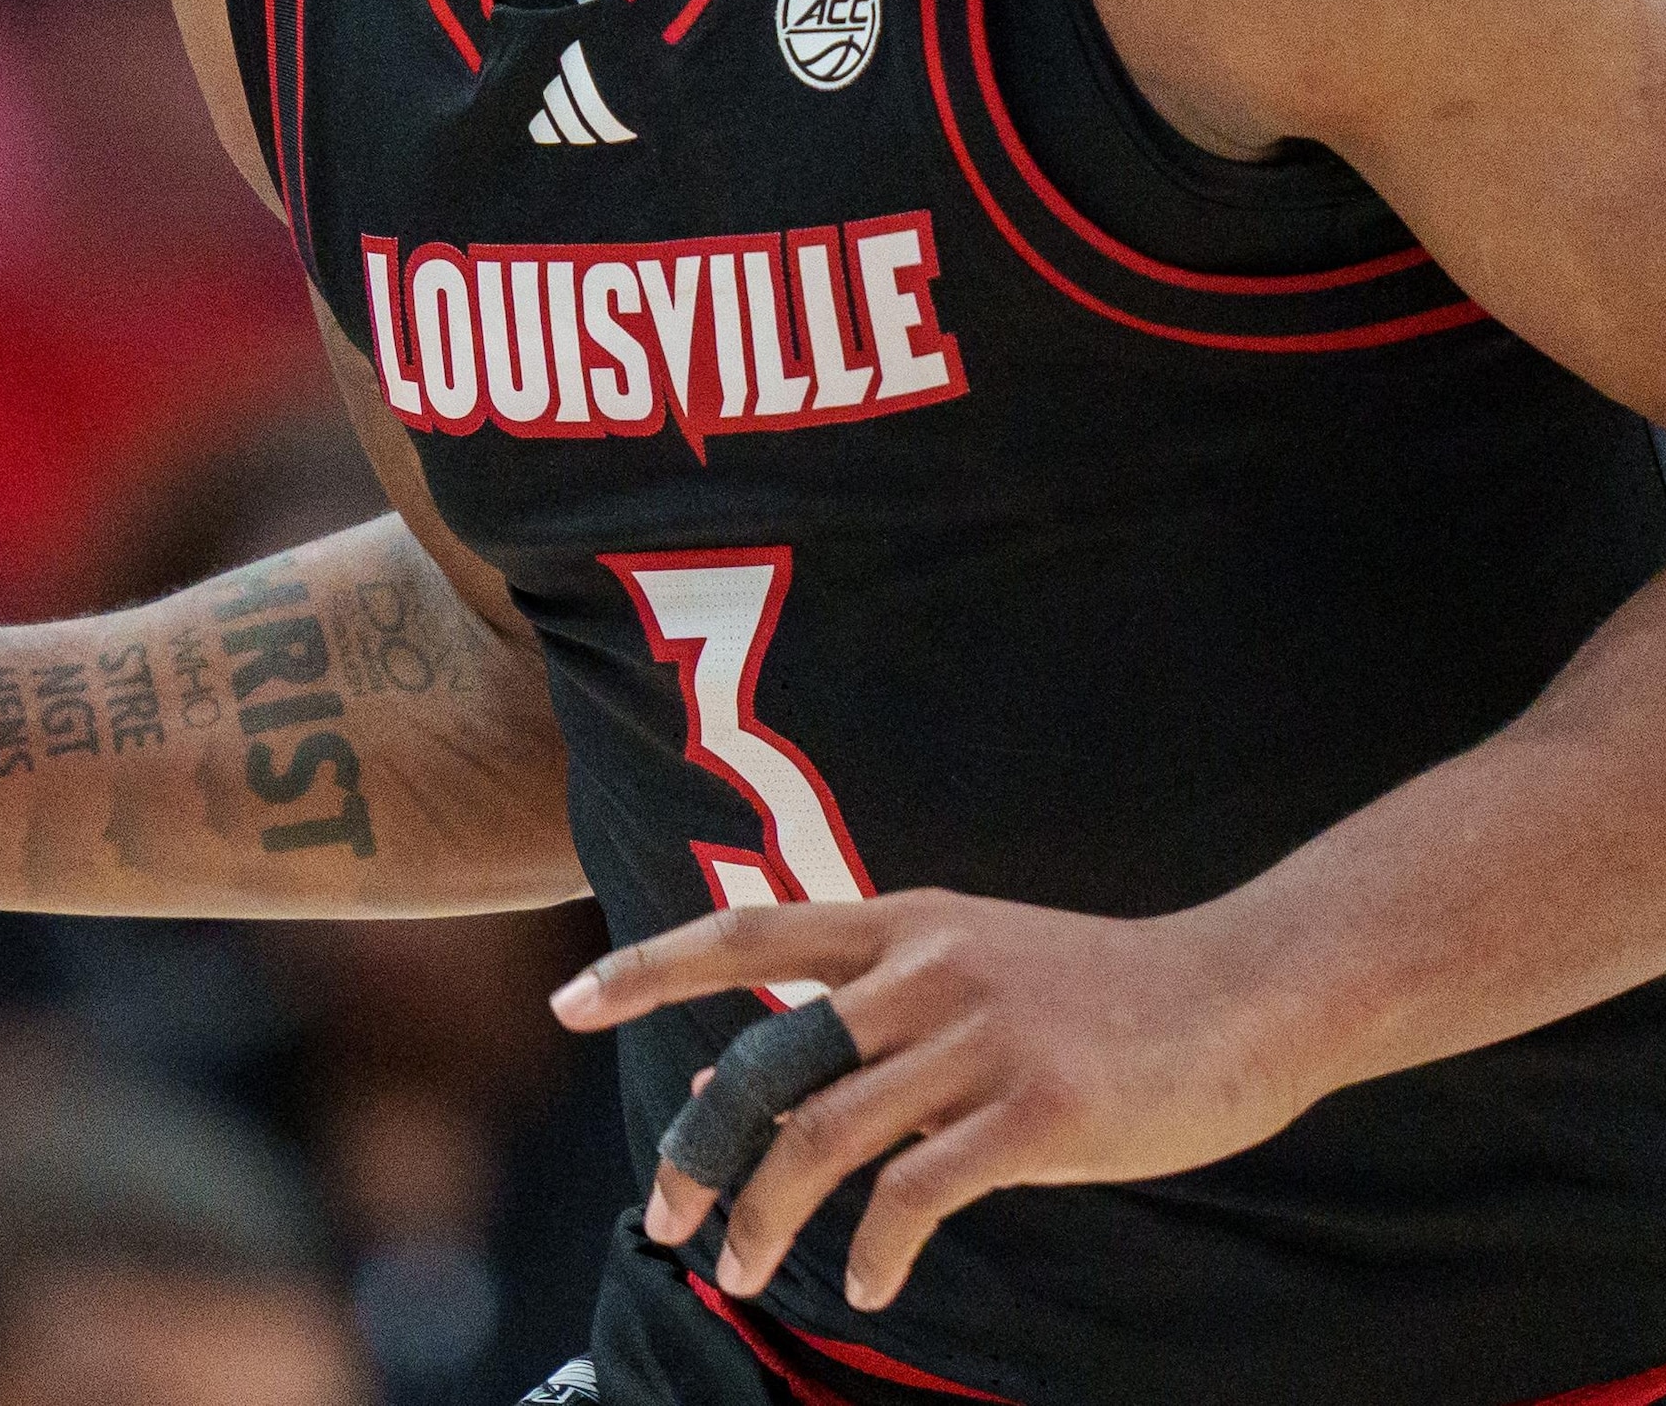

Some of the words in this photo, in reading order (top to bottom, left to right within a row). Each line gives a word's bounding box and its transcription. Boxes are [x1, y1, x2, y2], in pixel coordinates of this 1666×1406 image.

[361, 214, 965, 442] LOUISVILLE
[32, 663, 99, 756] NGT
[100, 643, 164, 754] STRE
[597, 545, 878, 1012] 3
